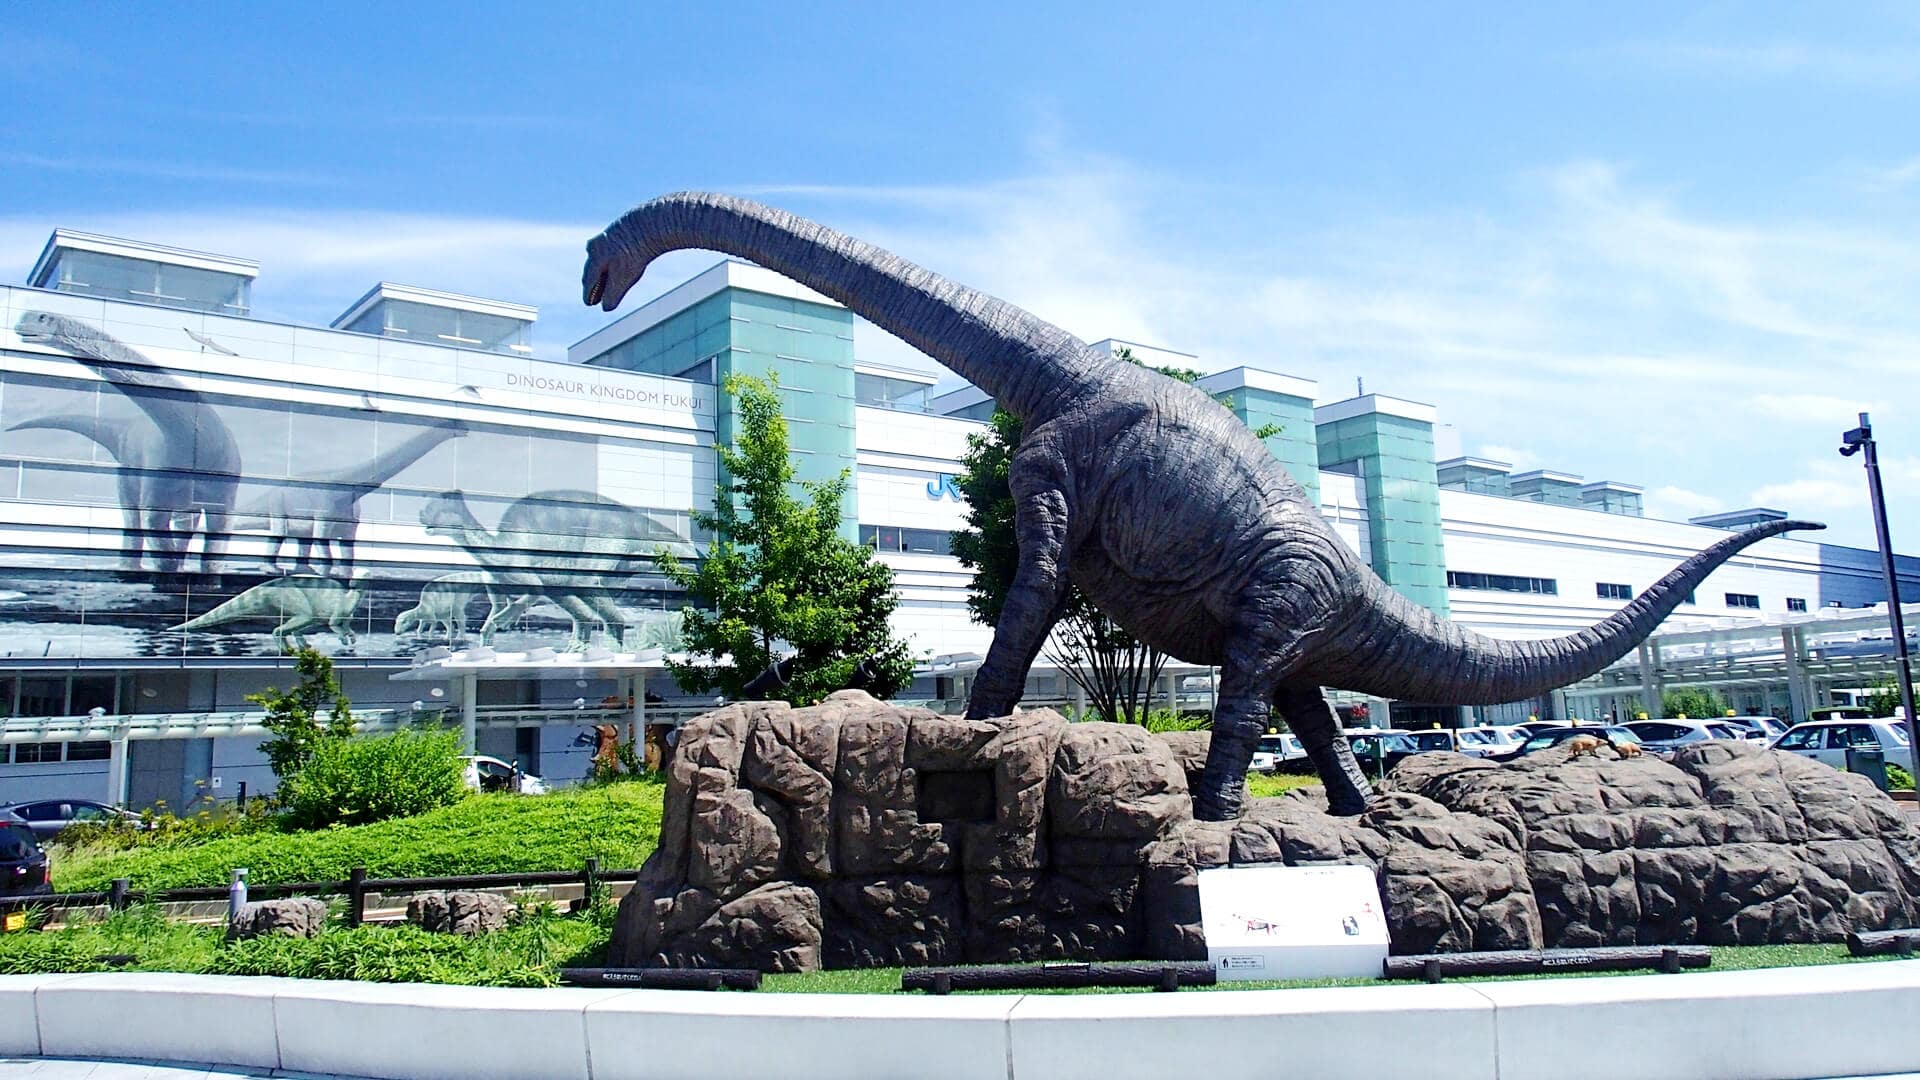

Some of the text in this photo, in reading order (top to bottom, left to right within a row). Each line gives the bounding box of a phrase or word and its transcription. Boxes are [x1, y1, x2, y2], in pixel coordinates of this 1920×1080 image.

[507, 373, 702, 409] DINOSAUR KINGDOM FUKUI
